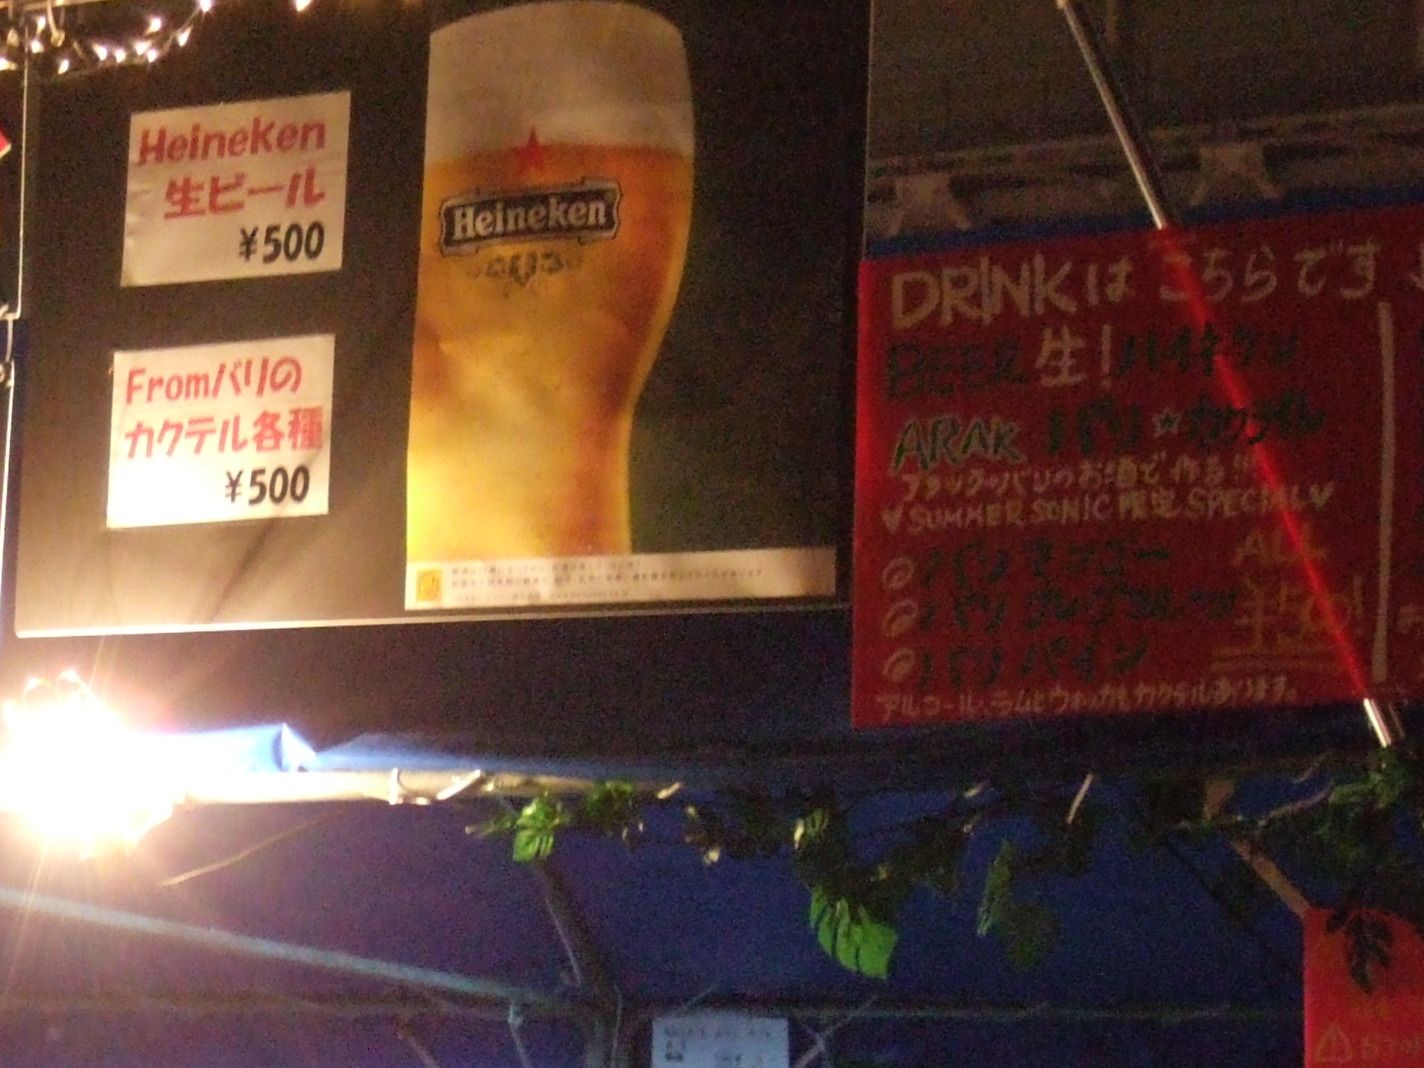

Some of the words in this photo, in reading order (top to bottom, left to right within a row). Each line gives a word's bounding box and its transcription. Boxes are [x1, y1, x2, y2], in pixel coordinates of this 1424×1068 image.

[163, 168, 325, 220] 生ビール
[453, 196, 606, 241] Heineken
[238, 221, 325, 262] ¥500
[123, 406, 324, 460] カクテル各種
[892, 413, 1026, 473] ARAK
[225, 465, 311, 505] ¥500
[1031, 494, 1110, 524] SONIC
